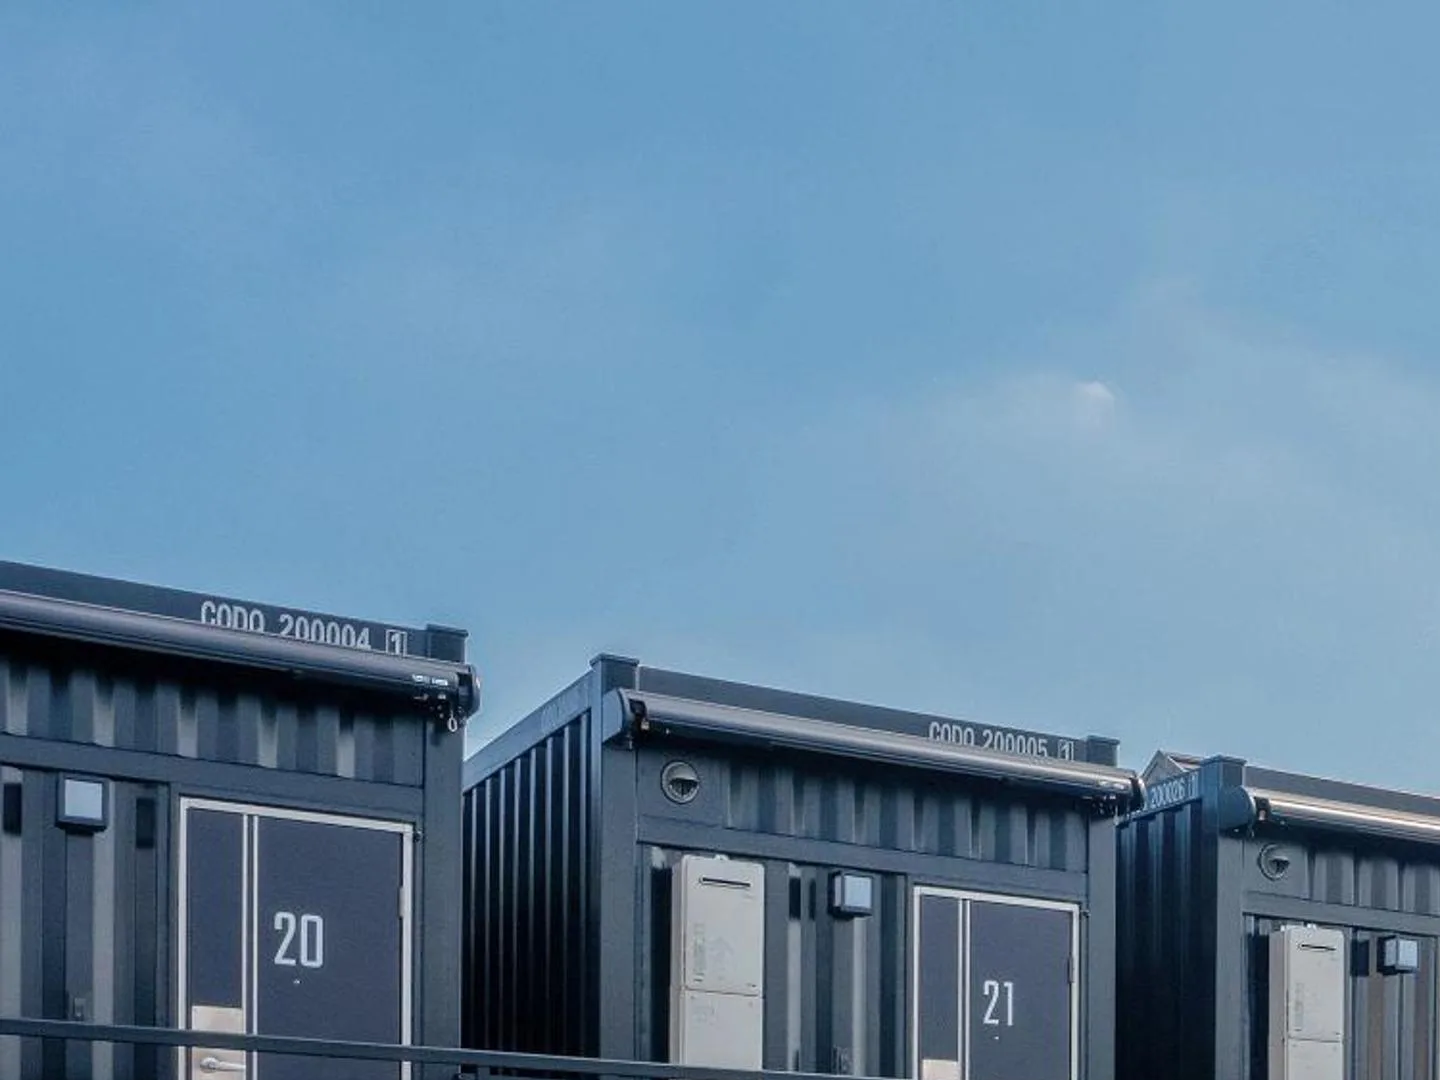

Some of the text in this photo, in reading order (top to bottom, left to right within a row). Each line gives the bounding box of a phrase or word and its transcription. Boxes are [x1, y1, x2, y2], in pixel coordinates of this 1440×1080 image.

[279, 614, 372, 651] 200004
[274, 911, 323, 968] 20
[983, 980, 1014, 1026] 21
